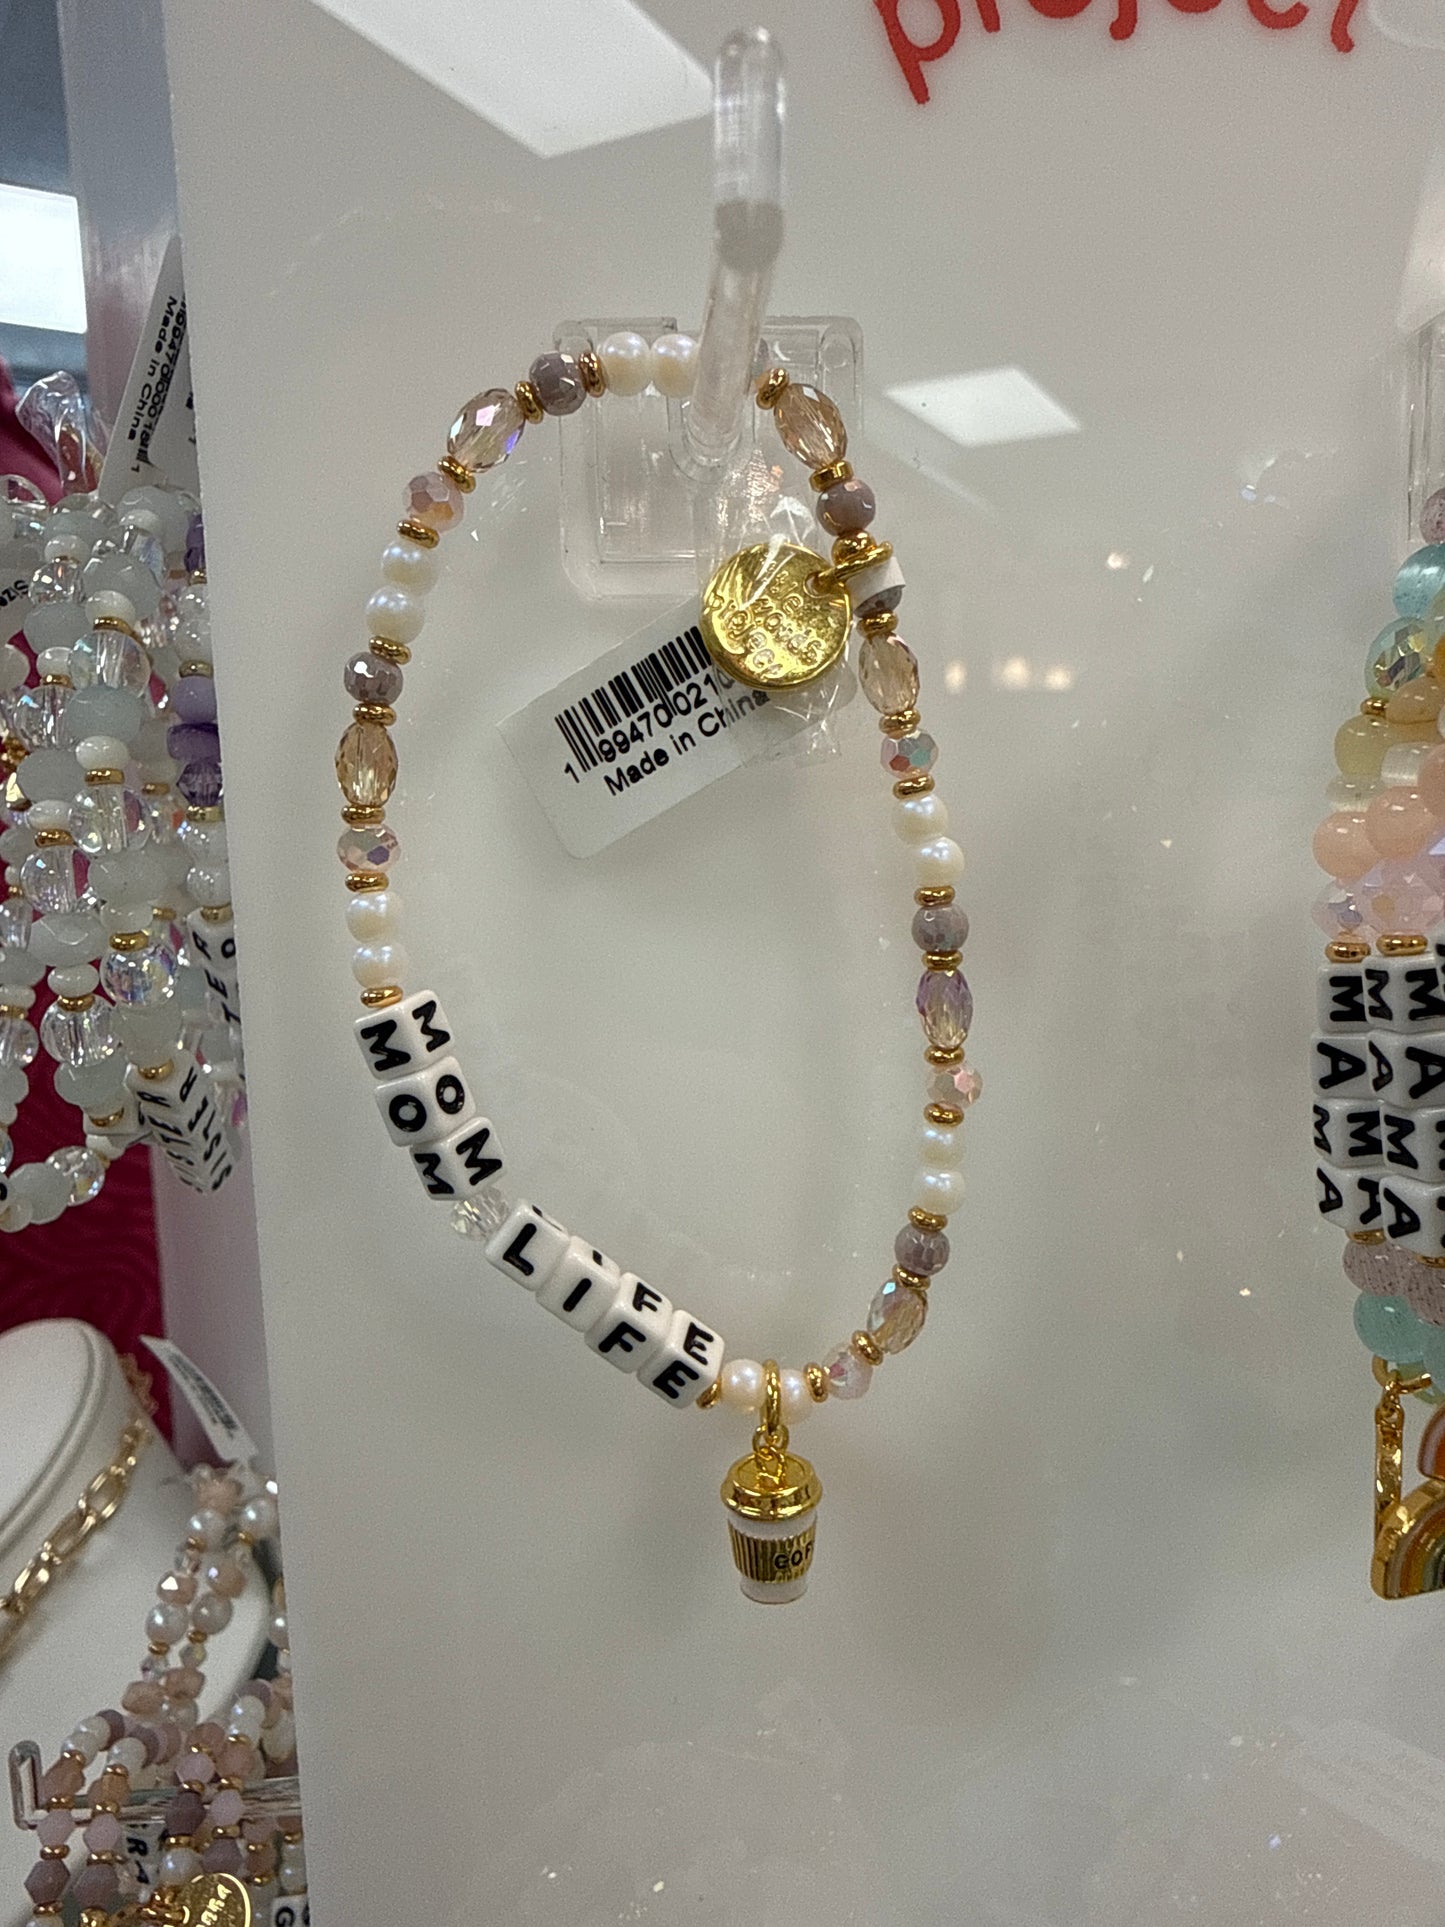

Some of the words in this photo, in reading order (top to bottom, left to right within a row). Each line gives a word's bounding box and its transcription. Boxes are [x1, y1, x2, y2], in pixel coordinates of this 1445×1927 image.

[154, 295, 178, 354] Made
[147, 358, 160, 377] in
[127, 383, 152, 441] China
[604, 750, 669, 796] Made
[669, 731, 697, 756] in
[697, 690, 770, 738] China
[412, 999, 503, 1187] MOM
[361, 1018, 454, 1195] MOM
[502, 1222, 700, 1400] LIFE
